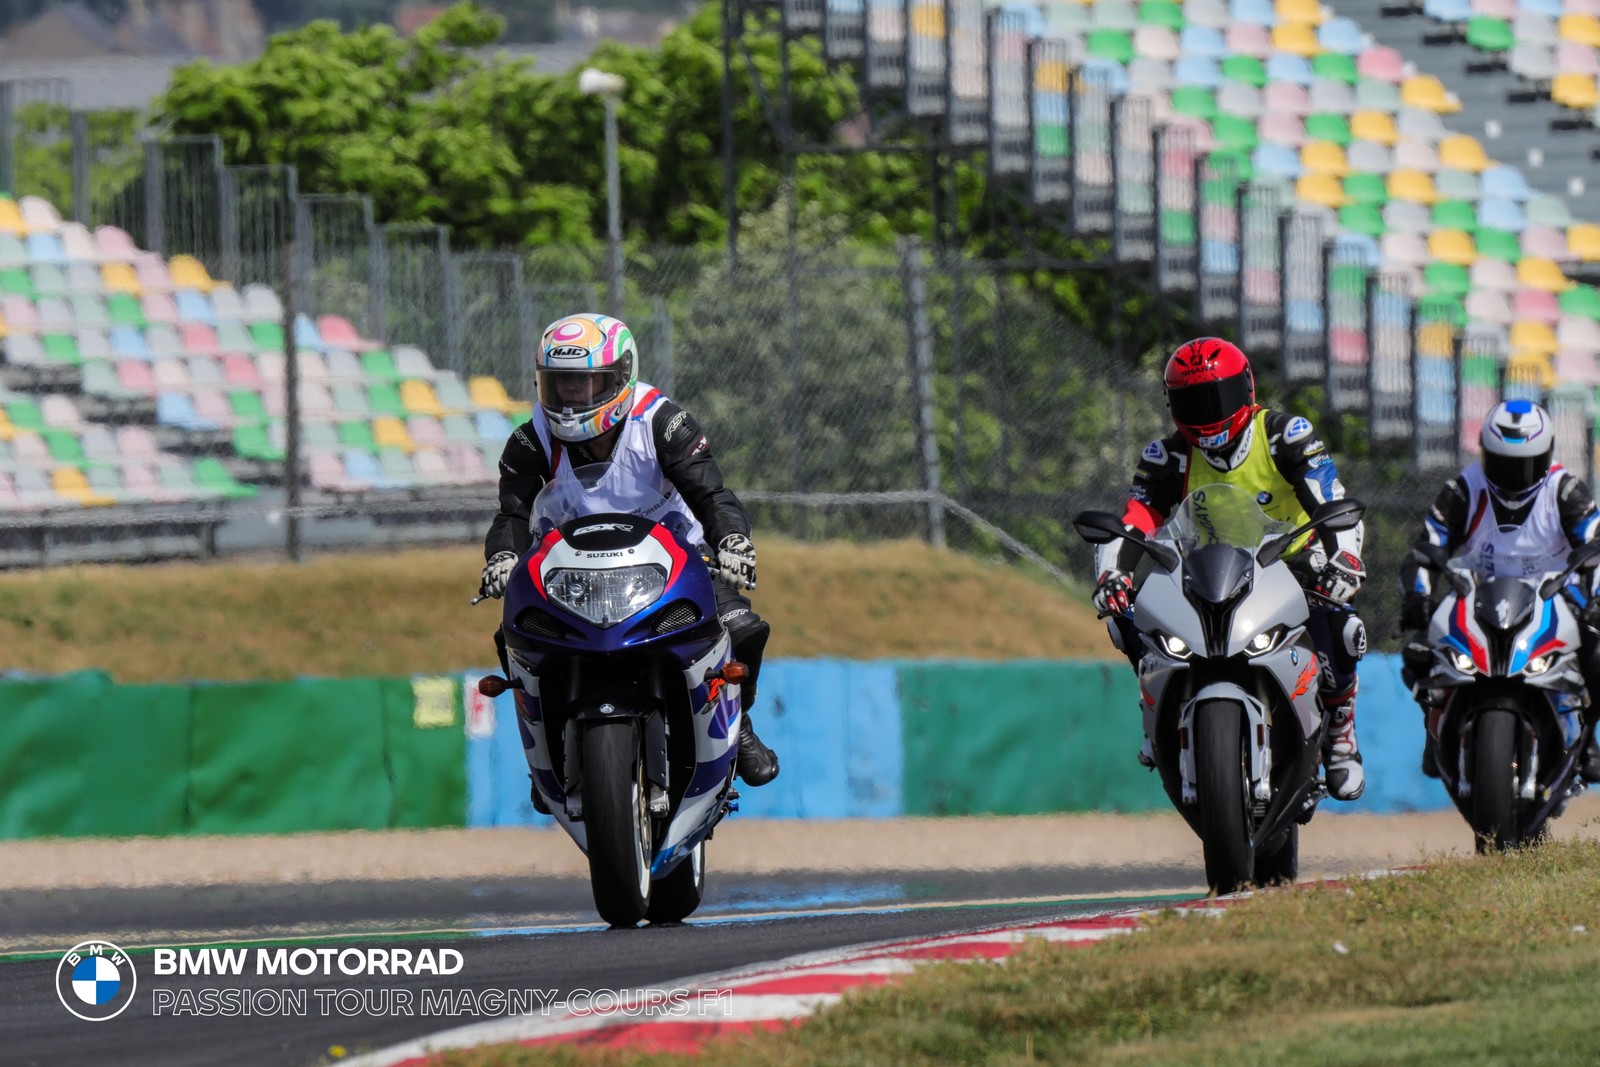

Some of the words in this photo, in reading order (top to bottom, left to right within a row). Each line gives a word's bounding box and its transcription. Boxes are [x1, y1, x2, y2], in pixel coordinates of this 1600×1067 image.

[552, 347, 583, 356] HJC
[1181, 364, 1216, 377] SHARK
[586, 551, 624, 559] SUZUKI
[719, 608, 749, 623] RST
